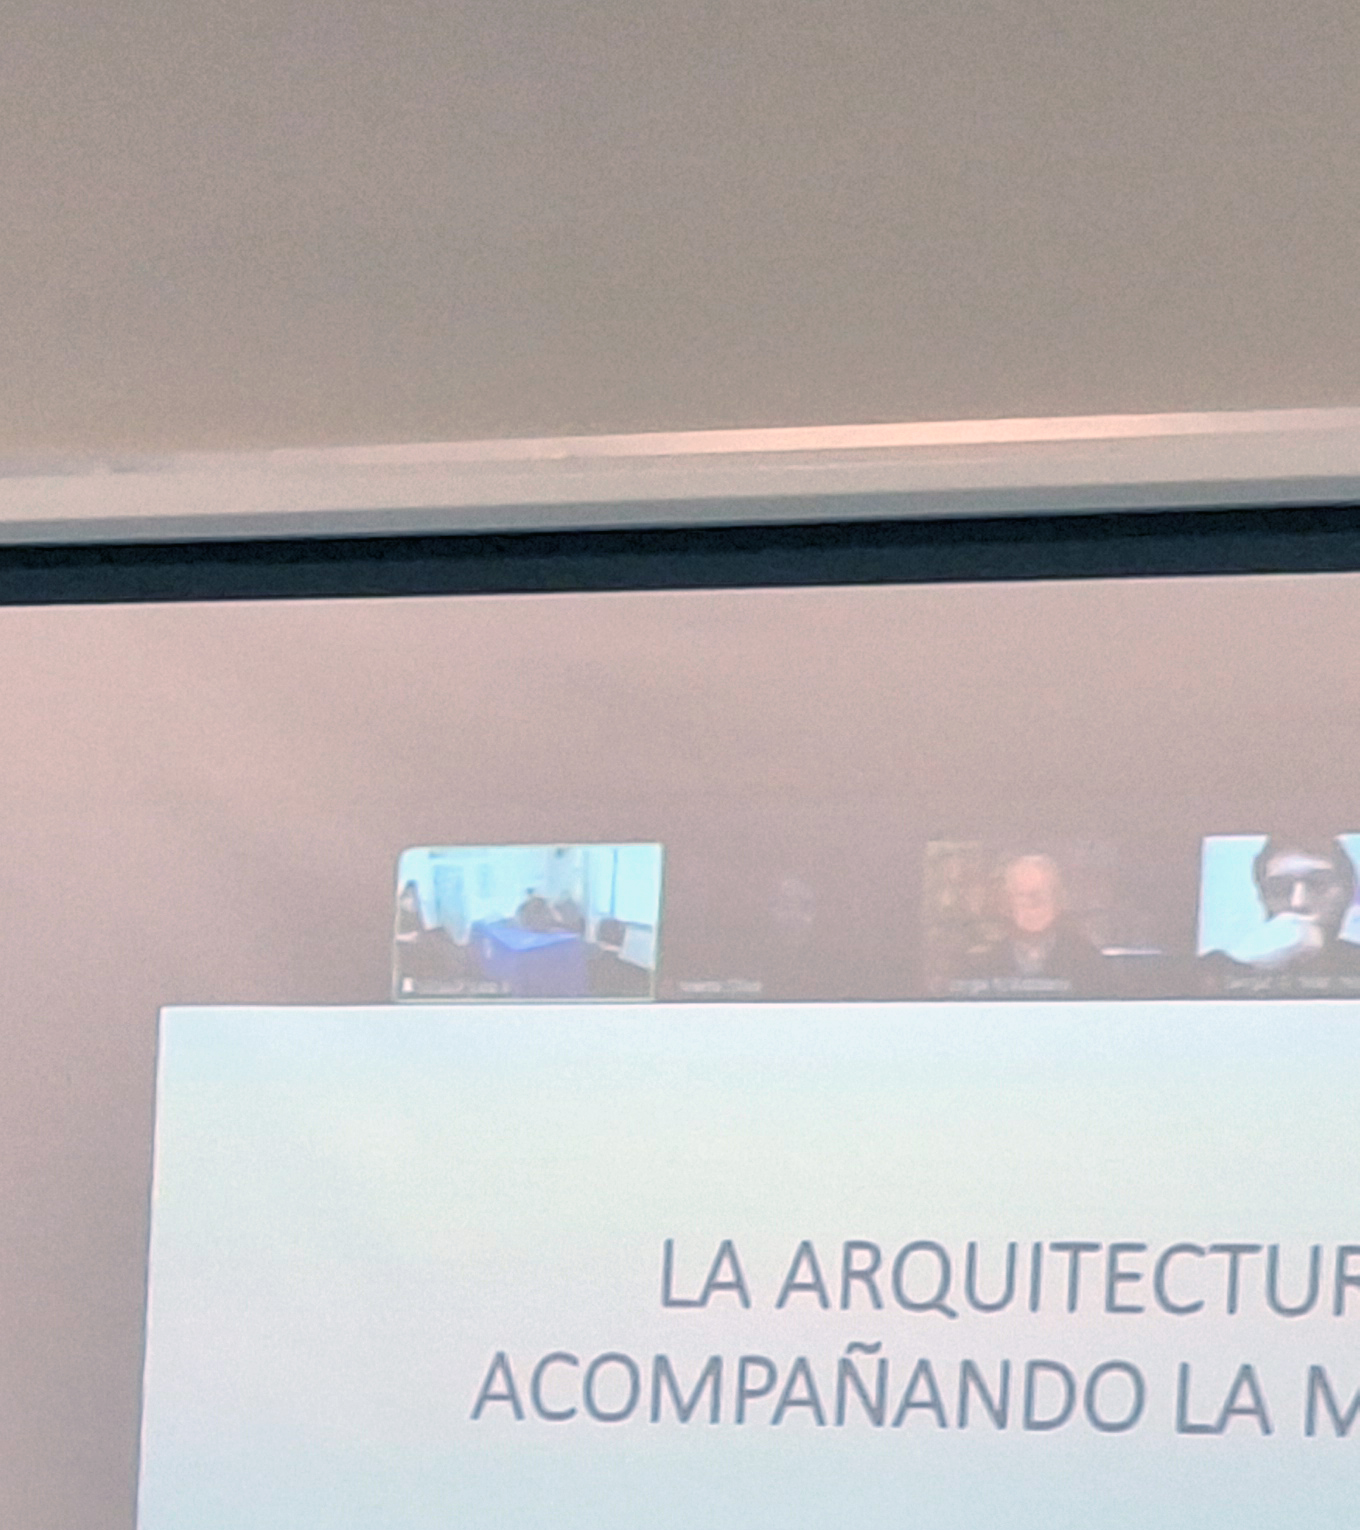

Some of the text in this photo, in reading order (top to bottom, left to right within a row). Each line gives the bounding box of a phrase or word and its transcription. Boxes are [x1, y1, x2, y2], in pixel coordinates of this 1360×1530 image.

[660, 1237, 1360, 1320] LA ARQUITECTUR
[469, 1340, 1360, 1438] ACOMPAÑANDO LA M
